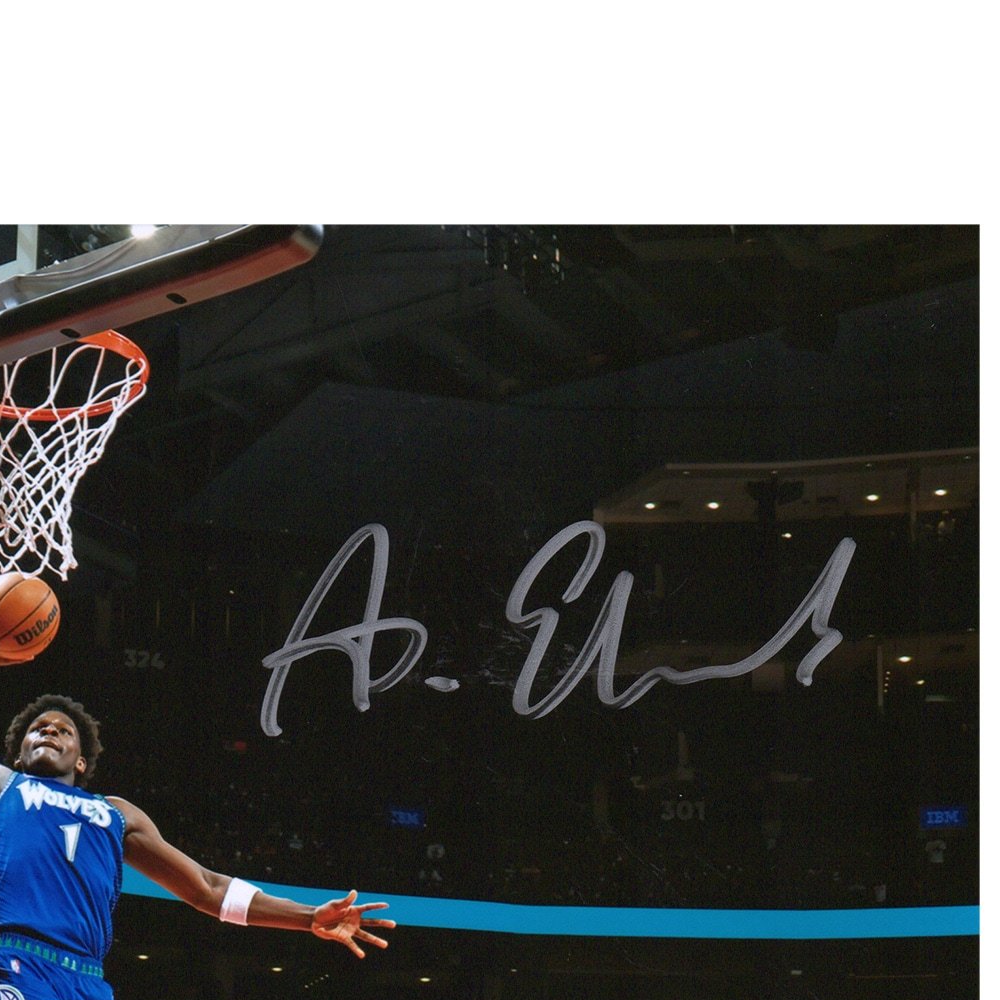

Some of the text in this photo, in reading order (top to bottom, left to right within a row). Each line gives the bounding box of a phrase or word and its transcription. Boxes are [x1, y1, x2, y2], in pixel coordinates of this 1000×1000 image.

[14, 604, 58, 646] Wilson
[16, 780, 113, 829] WOLVES
[660, 800, 706, 821] 301
[926, 810, 960, 824] IBM
[59, 822, 82, 863] 1
